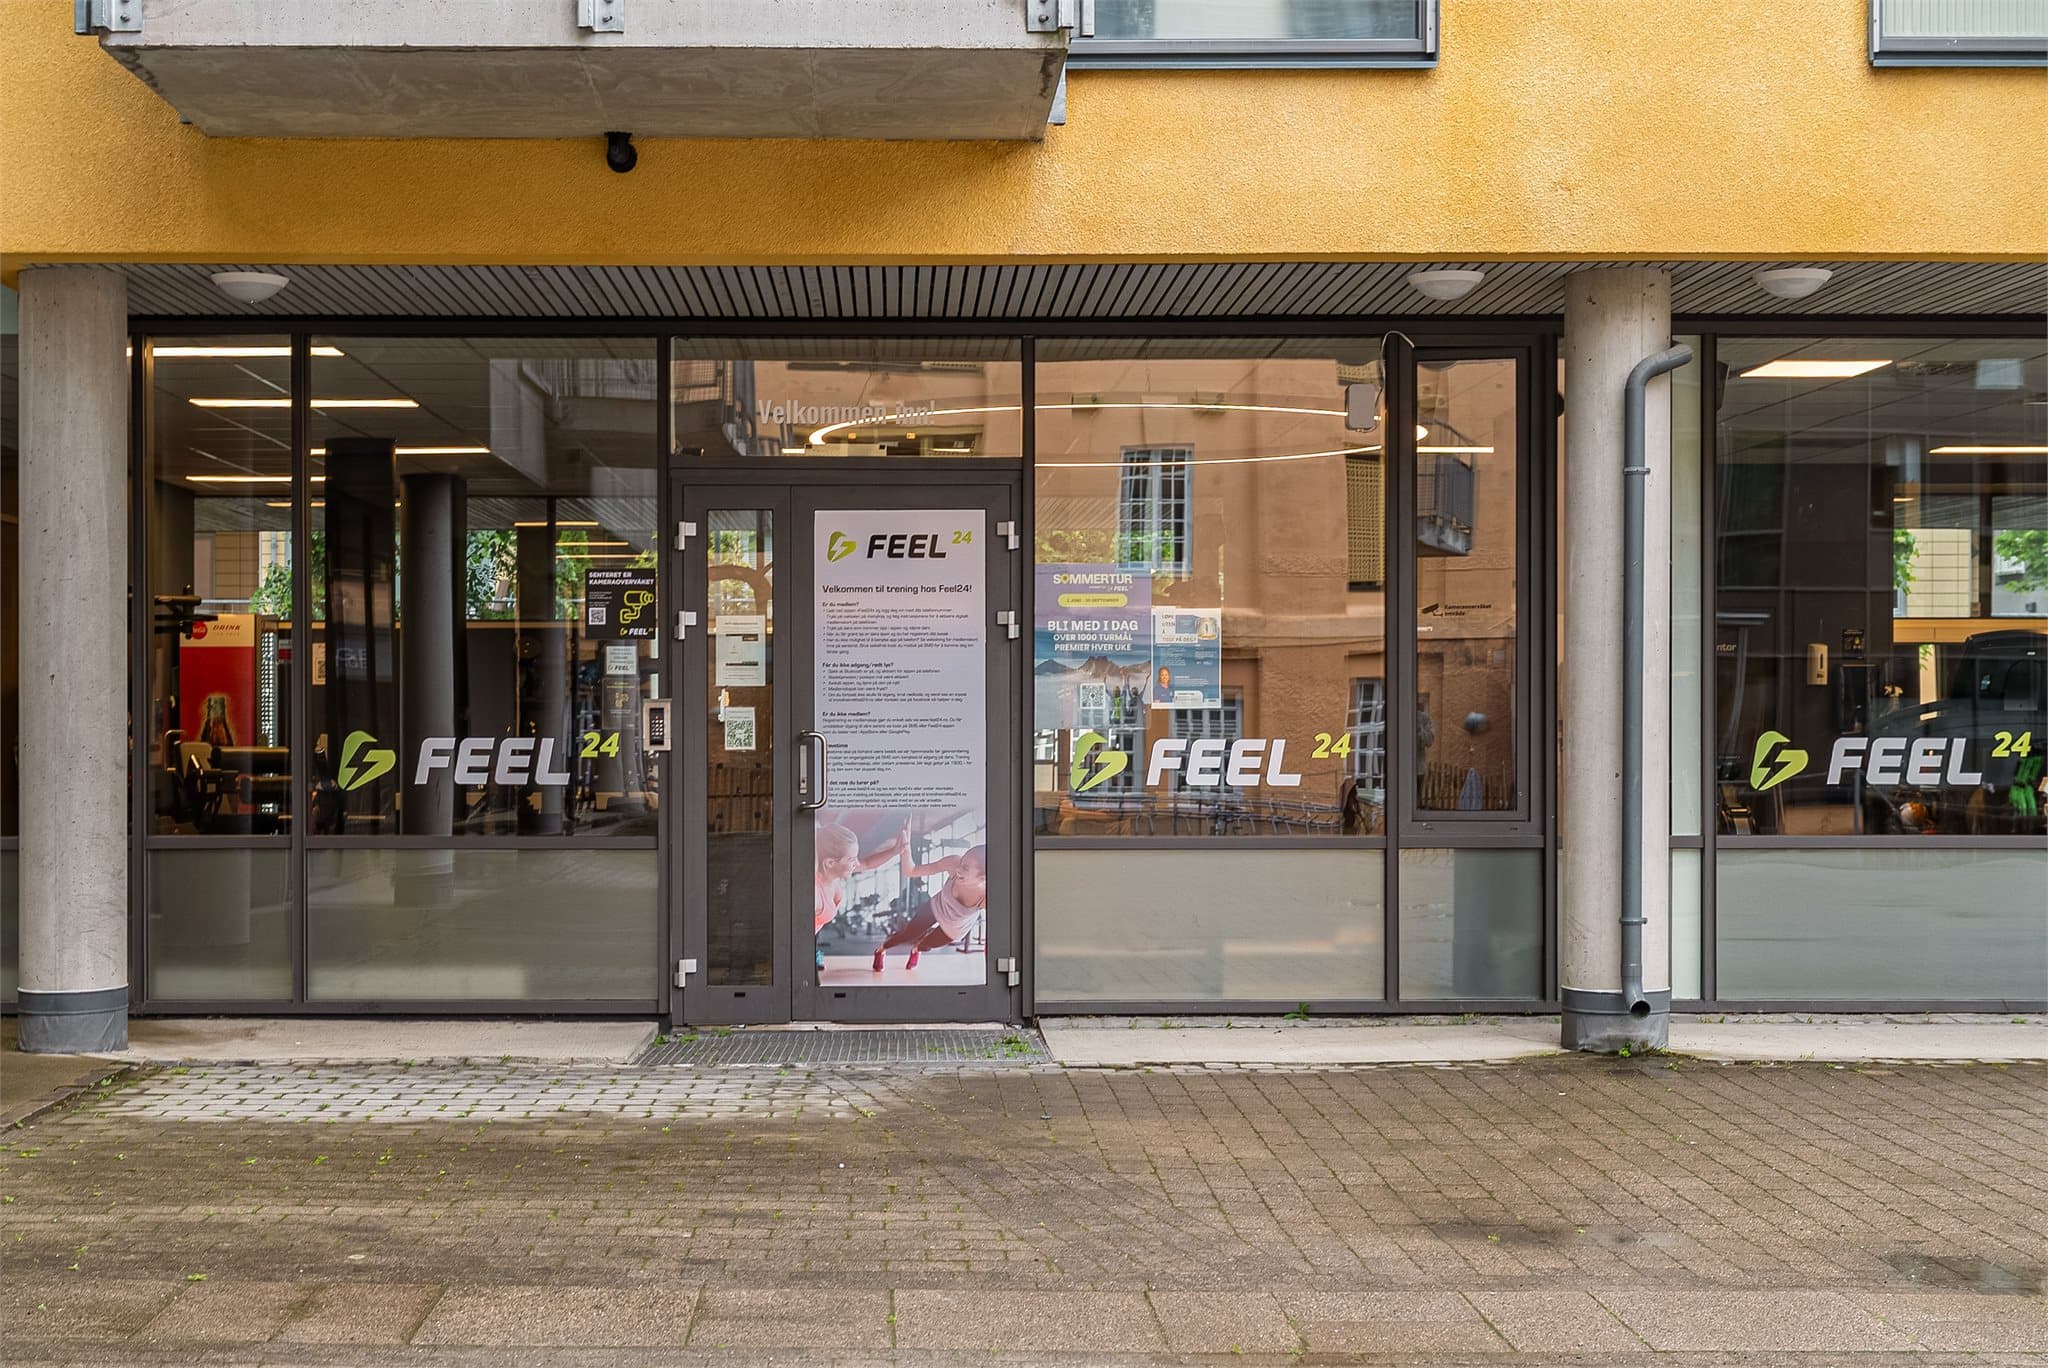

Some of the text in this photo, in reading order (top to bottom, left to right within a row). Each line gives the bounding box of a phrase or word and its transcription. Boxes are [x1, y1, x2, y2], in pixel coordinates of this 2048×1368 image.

[758, 400, 936, 425] Velkommen inn!
[866, 530, 973, 559] FEEL 24
[1053, 573, 1133, 585] SOMMERTUR
[822, 584, 973, 595] Velkommen til trening hos Feel24!
[1047, 620, 1138, 631] BLI MED I DAG
[1053, 631, 1133, 641] OVER 1000 TURMÅL
[1054, 643, 1132, 651] PREMIER HVER UKE
[414, 731, 620, 785] FEEL 24
[1146, 732, 1351, 786] FEEL 24
[1826, 731, 2032, 785] FEEL 24
